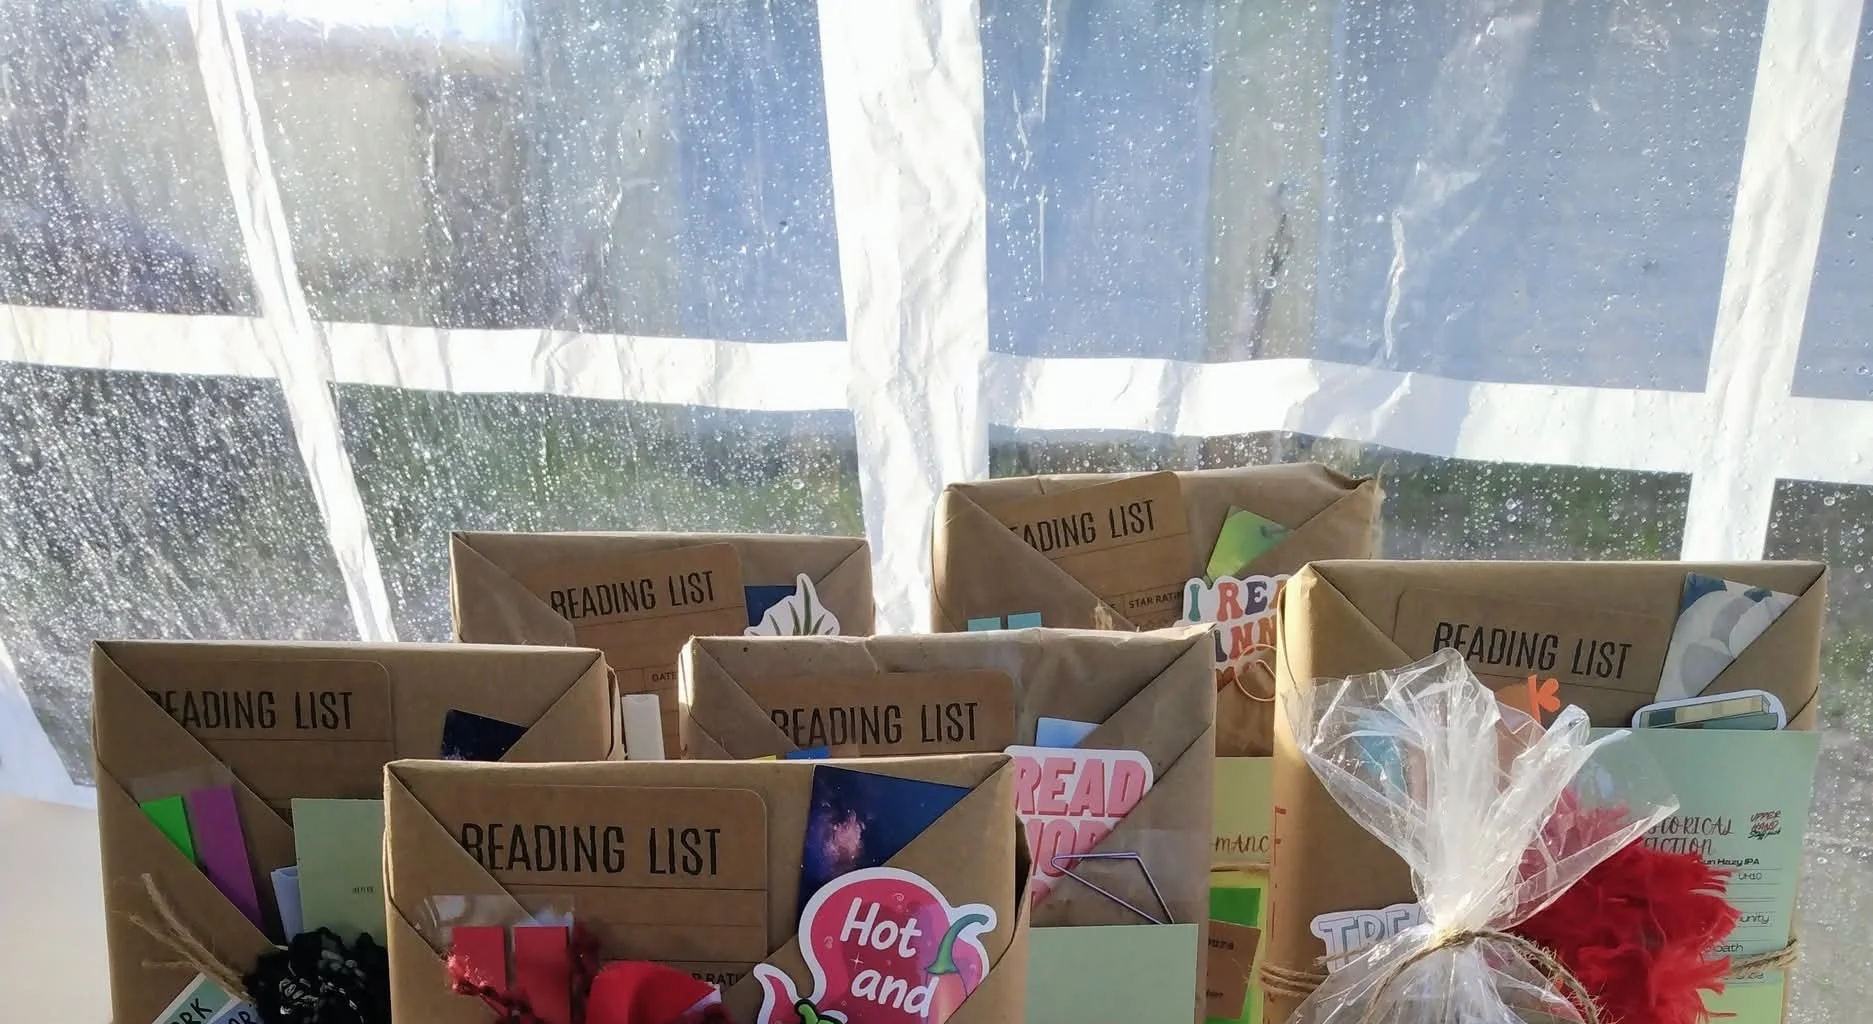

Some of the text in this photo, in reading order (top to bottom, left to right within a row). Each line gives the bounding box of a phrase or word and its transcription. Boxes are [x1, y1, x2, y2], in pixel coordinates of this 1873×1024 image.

[1109, 501, 1154, 538] LIST
[668, 570, 715, 607] LIST
[1189, 583, 1201, 622] I
[1571, 638, 1632, 679] LIST
[295, 691, 353, 730] LIST
[921, 702, 978, 743] LIST
[1015, 756, 1147, 818] READ
[461, 823, 721, 876] READING LIST
[840, 897, 922, 958] Hot
[851, 969, 940, 1018] and
